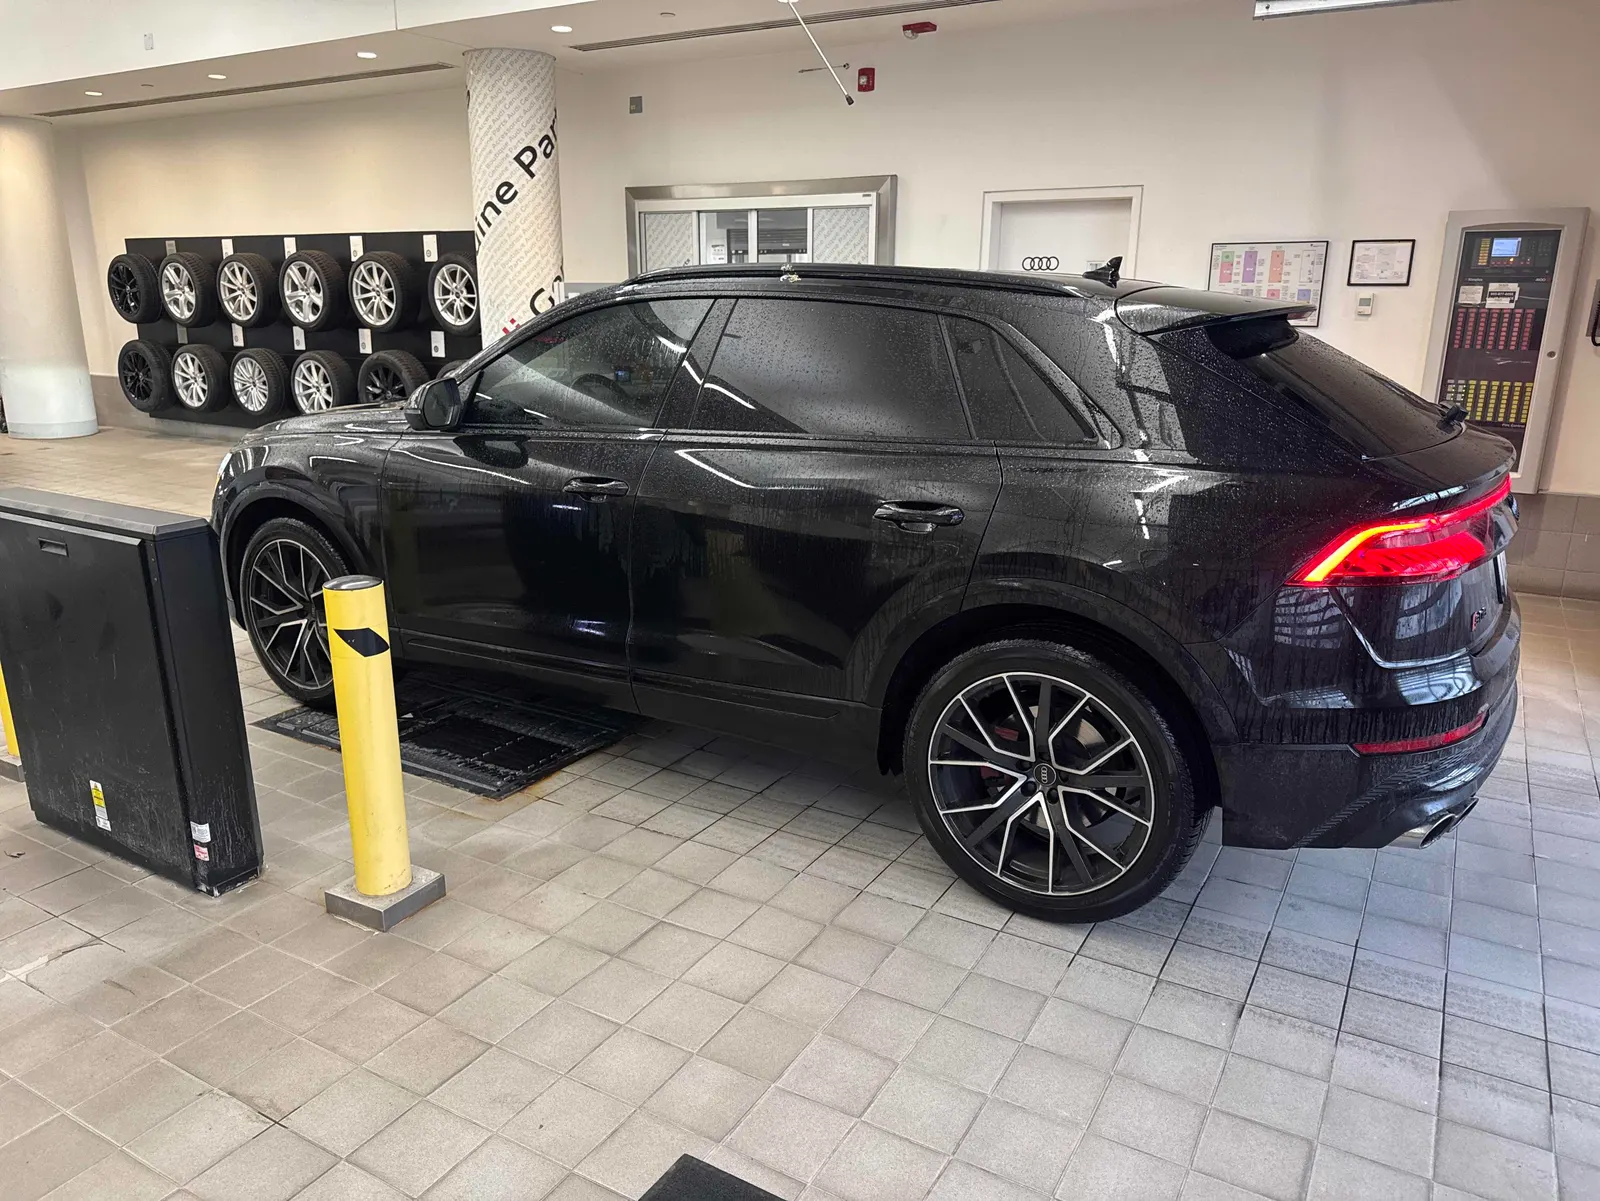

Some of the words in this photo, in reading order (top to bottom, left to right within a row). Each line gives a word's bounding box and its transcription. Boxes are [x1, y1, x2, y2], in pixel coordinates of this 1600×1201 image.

[489, 86, 504, 102] Audi
[491, 108, 506, 125] Audi
[503, 84, 528, 111] Genuine
[506, 103, 521, 120] Audi
